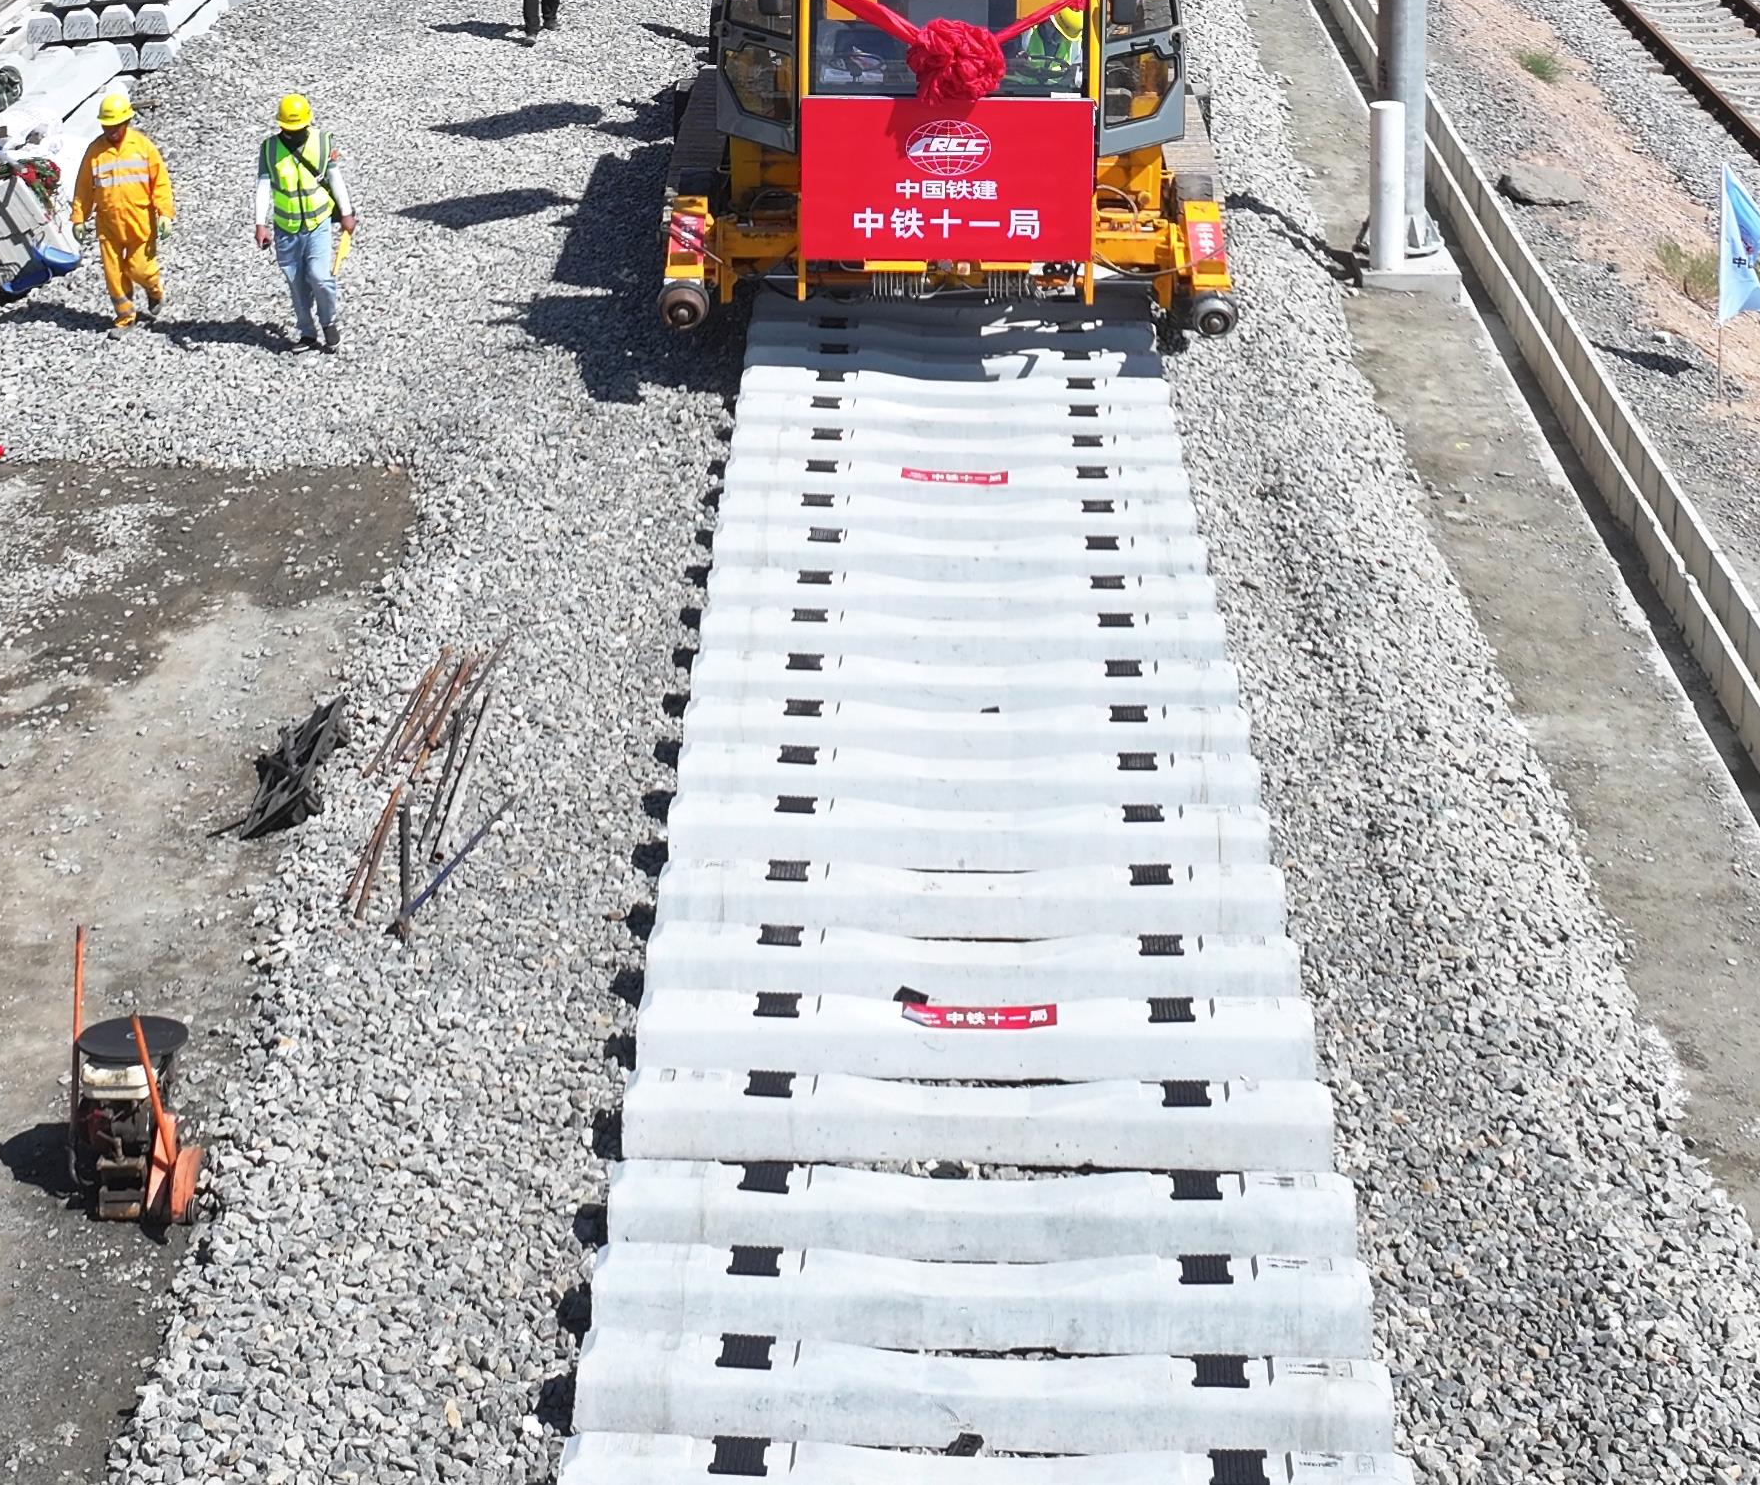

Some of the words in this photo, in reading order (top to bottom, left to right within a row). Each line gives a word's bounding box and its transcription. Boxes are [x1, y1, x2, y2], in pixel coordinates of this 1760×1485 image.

[908, 137, 989, 157] CRCC
[896, 179, 998, 201] 中国铁建
[852, 208, 1042, 240] 中铁十一局
[945, 1008, 1048, 1026] 中铁十一局
